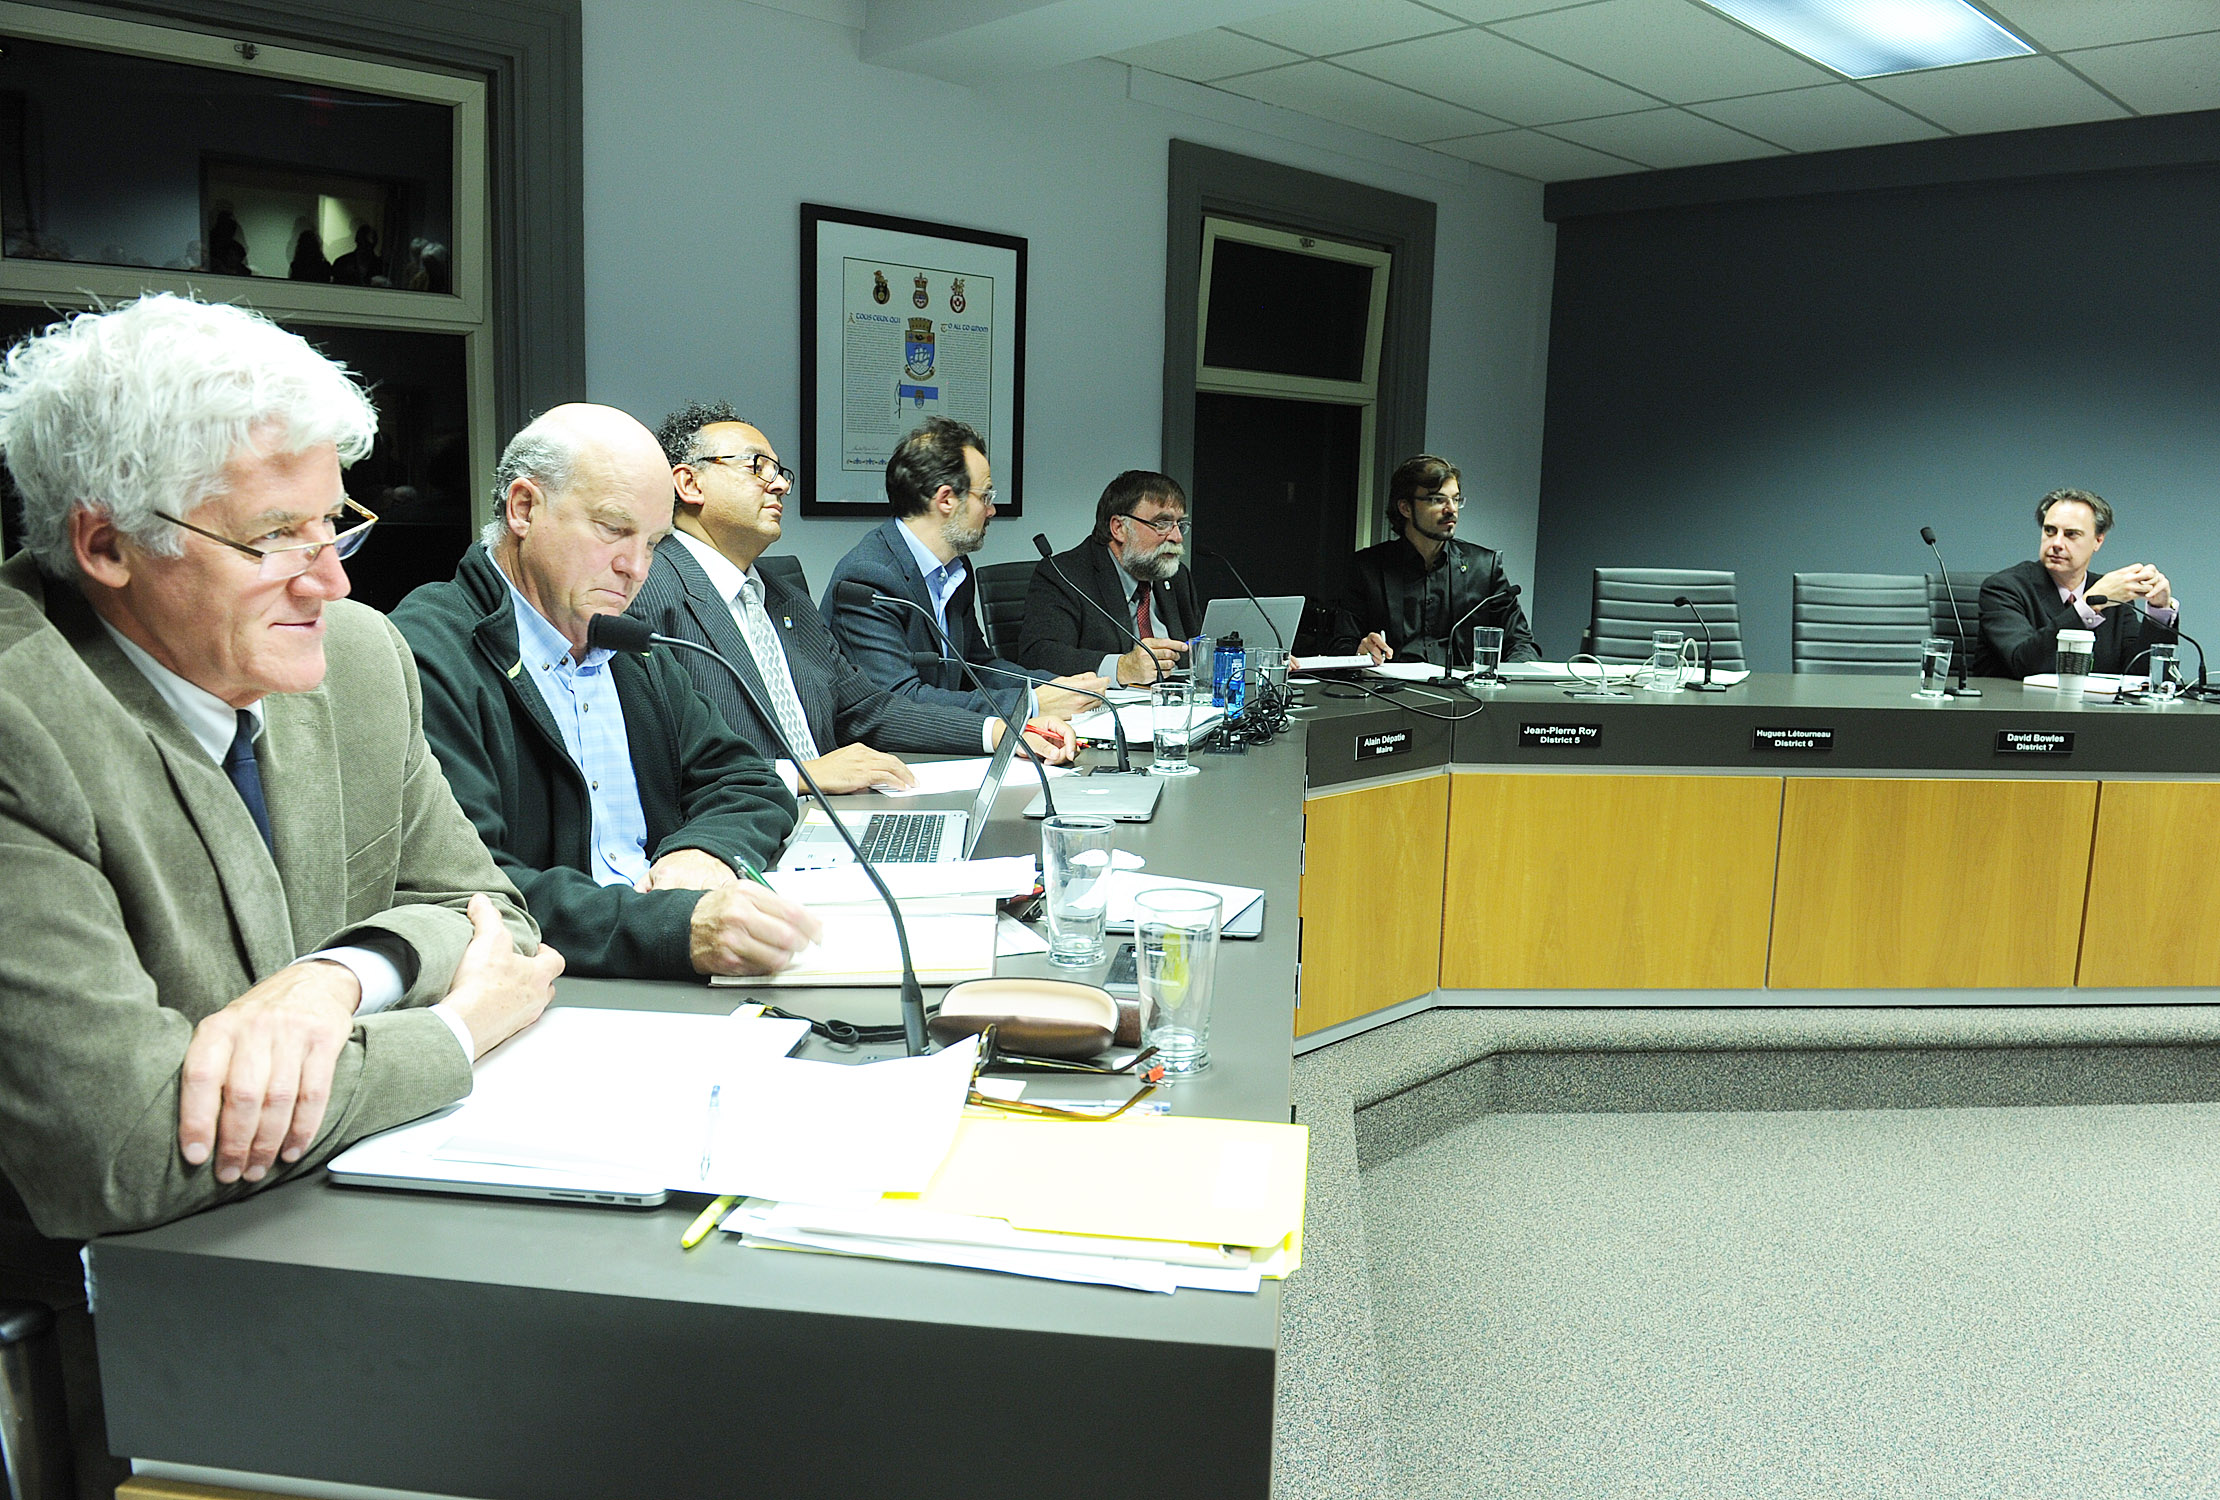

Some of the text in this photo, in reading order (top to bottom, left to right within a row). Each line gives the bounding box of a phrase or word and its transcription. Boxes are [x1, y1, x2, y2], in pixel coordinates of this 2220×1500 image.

[1523, 726, 1597, 737] Jean-Pierre Roy
[1756, 729, 1831, 739] Hugues Létourneau
[1363, 733, 1406, 747] Alain Dépatie
[1540, 736, 1581, 744] District 5
[2007, 733, 2065, 743] David Bowles
[1774, 739, 1814, 747] District 6
[2016, 742, 2054, 751] District 7
[1376, 745, 1394, 754] Maire
